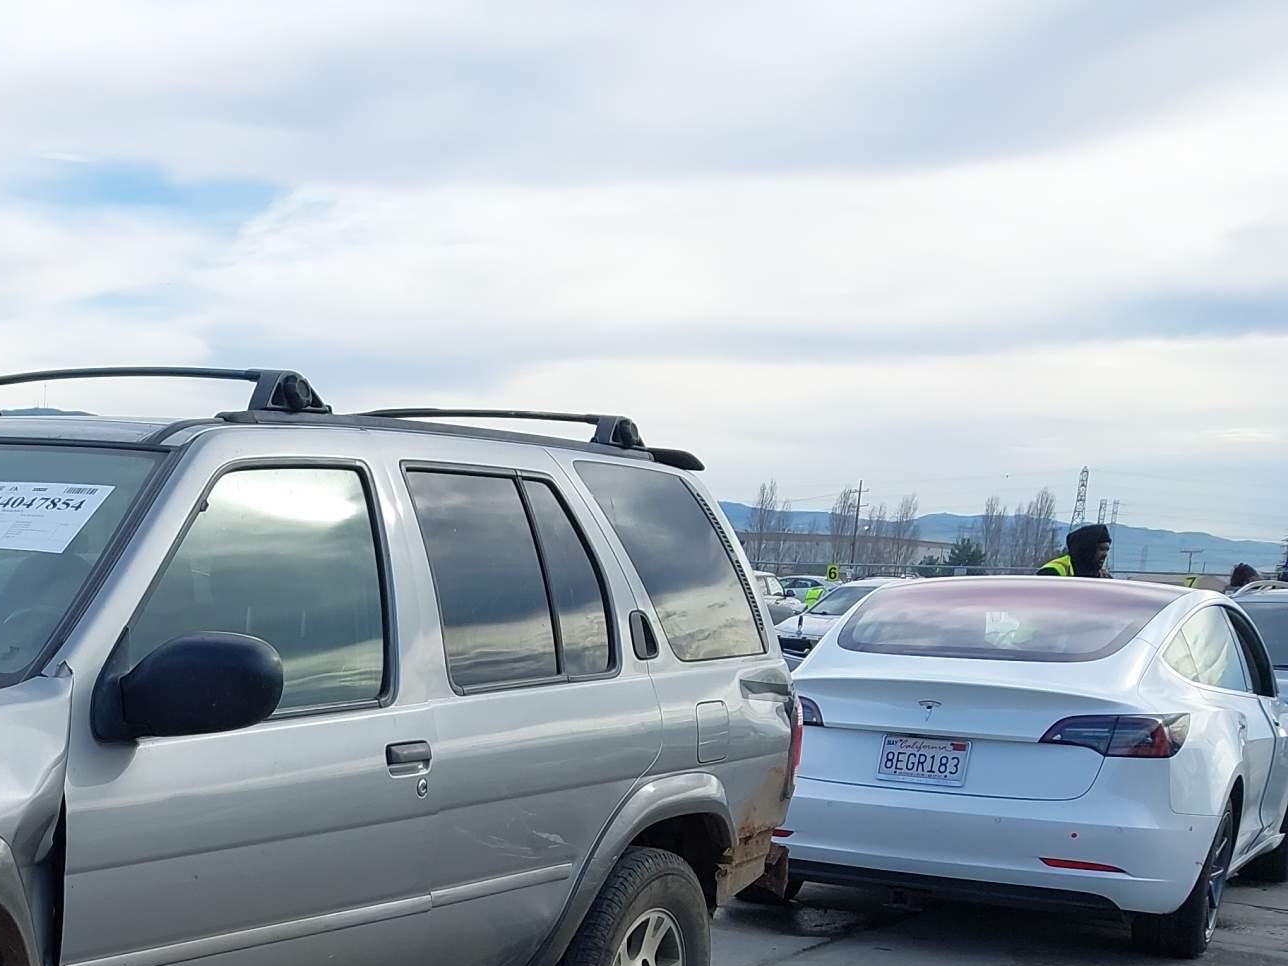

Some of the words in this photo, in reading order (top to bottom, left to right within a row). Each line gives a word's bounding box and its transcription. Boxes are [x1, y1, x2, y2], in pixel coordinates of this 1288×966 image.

[828, 566, 837, 580] 6
[1186, 576, 1197, 588] 7
[899, 739, 950, 752] California
[884, 751, 960, 775] 8EGR183
